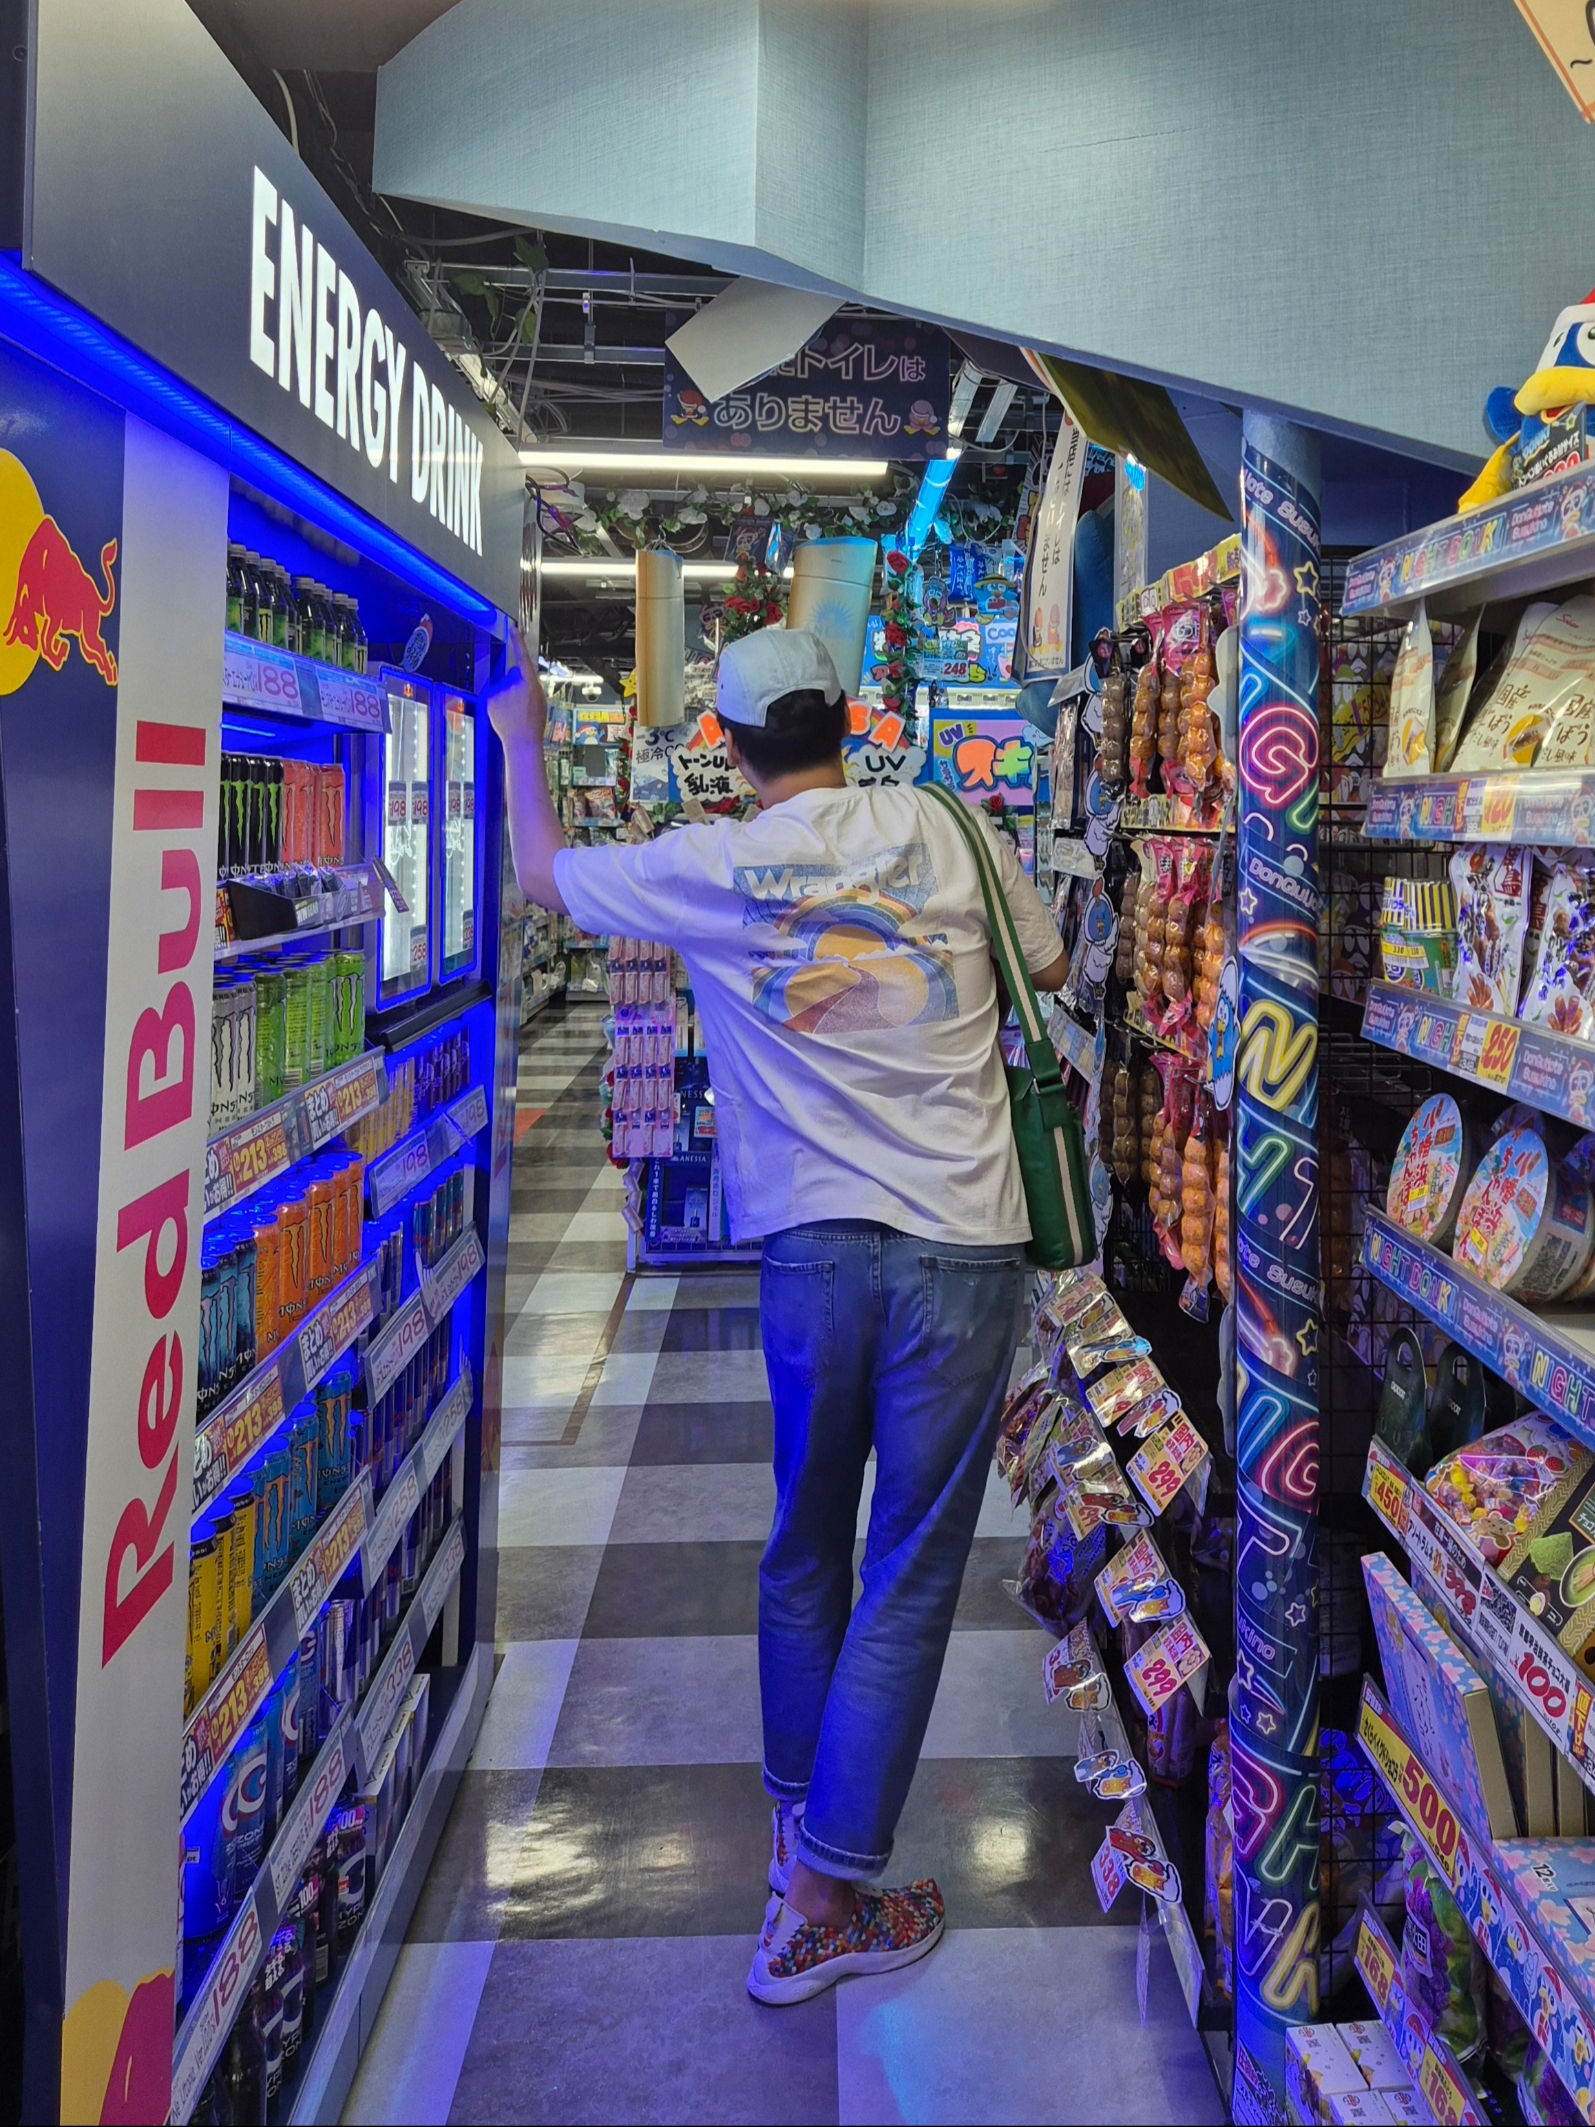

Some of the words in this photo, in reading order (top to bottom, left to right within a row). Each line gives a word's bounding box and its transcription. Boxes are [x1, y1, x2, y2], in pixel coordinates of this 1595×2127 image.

[250, 165, 406, 484] ENERGY
[411, 361, 483, 557] DRINK
[713, 392, 901, 436] ありません
[1522, 424, 1551, 460] DONKI
[256, 663, 299, 700] 188
[943, 663, 967, 676] 248
[350, 689, 381, 719] 188
[939, 723, 965, 747] UV
[684, 773, 734, 796] 乳液
[865, 754, 907, 773] UV
[390, 799, 407, 817] 198
[414, 799, 428, 817] 198
[744, 854, 922, 906] Wrangler
[124, 720, 207, 1151] Bull
[412, 943, 427, 962] 258
[1481, 1023, 1519, 1072] 250
[1523, 1050, 1564, 1076] DonQuijote
[342, 1081, 362, 1116] 213
[1522, 1068, 1558, 1091] Busukino
[241, 1138, 268, 1182] 213
[402, 1143, 428, 1180] 198
[680, 1154, 707, 1163] ANESSA
[457, 1243, 478, 1282] 198
[1370, 1231, 1411, 1278] NIGHT
[1409, 1260, 1458, 1324] DONKI
[337, 1299, 357, 1343] 213
[396, 1308, 426, 1360] 198
[1462, 1294, 1499, 1333] DonQuijote
[301, 1318, 324, 1361] まとめ
[1531, 1349, 1595, 1421] NIGHT
[101, 1168, 191, 1670] Red
[235, 1402, 263, 1456] 213
[443, 1393, 464, 1438] 258
[1173, 1423, 1196, 1450] 国内
[1147, 1460, 1182, 1498] 299
[1377, 1481, 1400, 1519] 450
[391, 1472, 418, 1531] 258
[331, 1523, 350, 1572] 213
[292, 1560, 316, 1609] まとめ
[1170, 1621, 1194, 1654] 国内
[252, 1665, 270, 1693] 398
[386, 1640, 412, 1701] 338
[1142, 1658, 1178, 1697] 299
[1518, 1651, 1567, 1718] 100
[218, 1679, 248, 1746] 213
[307, 1747, 343, 1826] 188
[1402, 1753, 1457, 1857] 500
[1098, 1845, 1121, 1900] 338
[211, 1909, 258, 2027] 188
[1364, 1944, 1389, 2002] 168
[1429, 2070, 1459, 2126] 168
